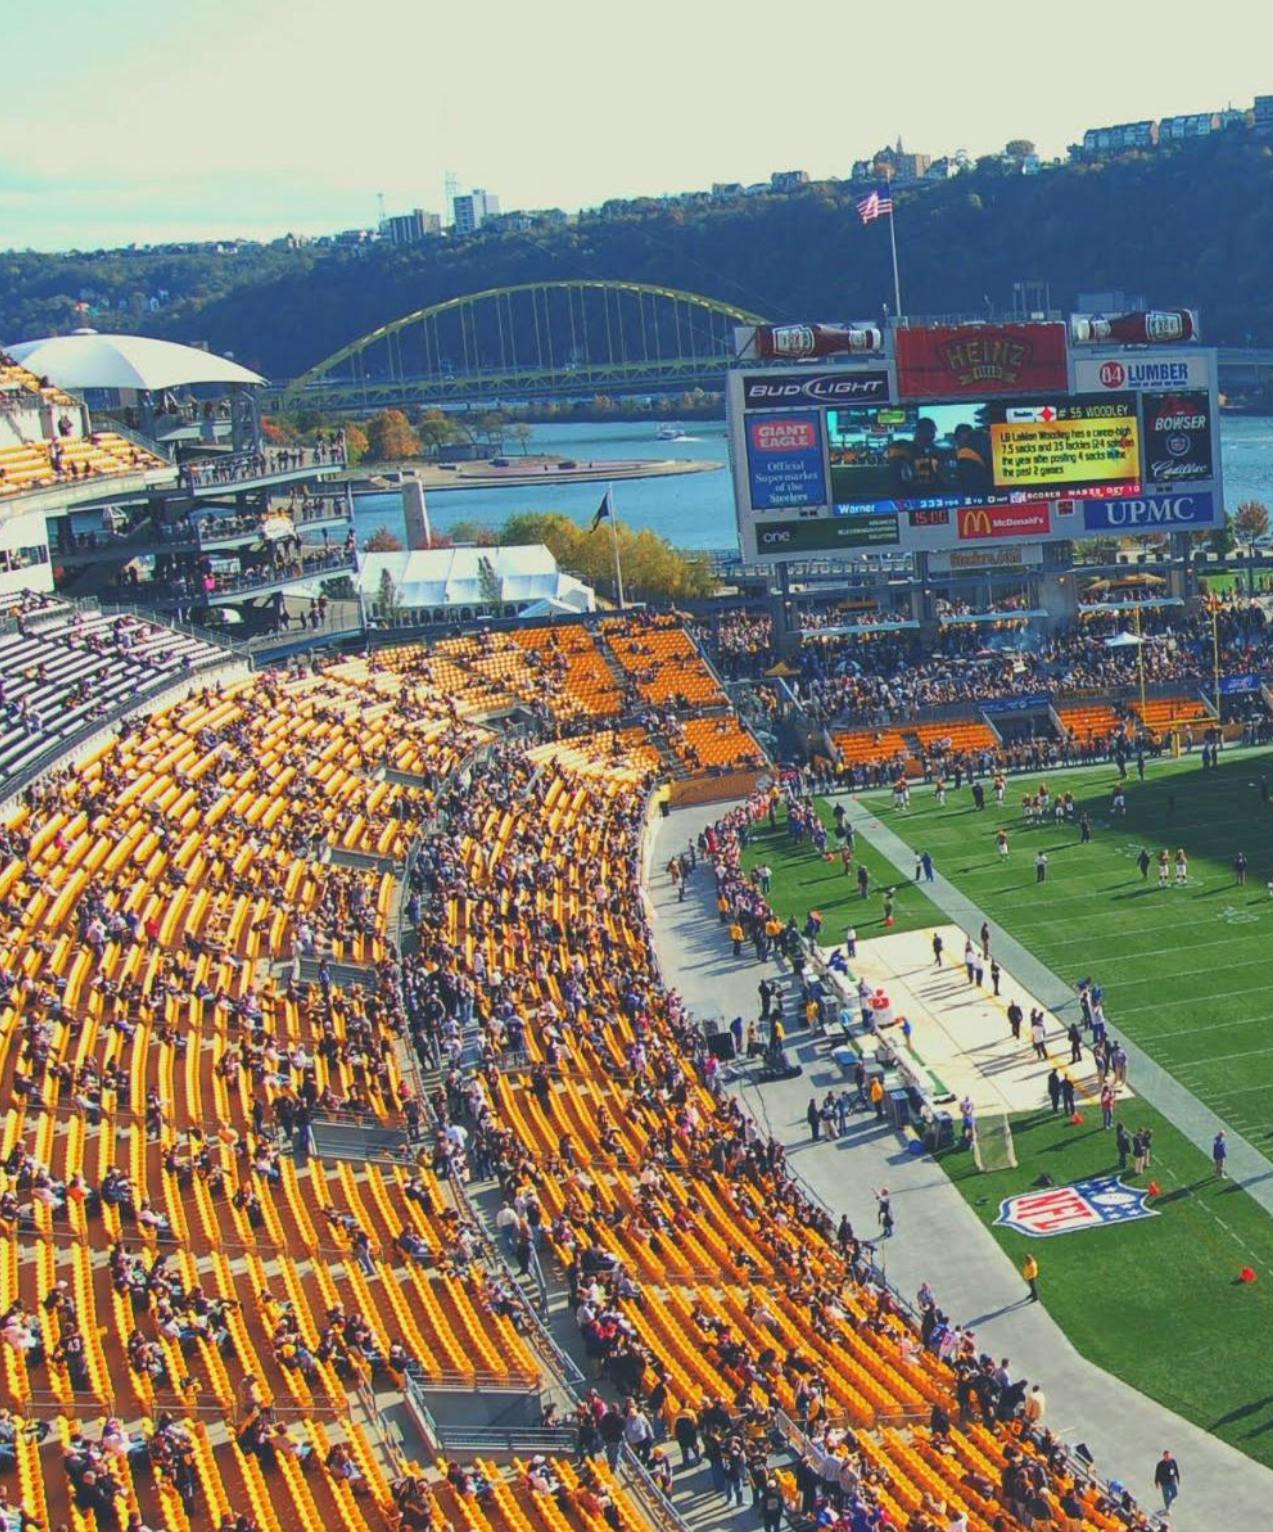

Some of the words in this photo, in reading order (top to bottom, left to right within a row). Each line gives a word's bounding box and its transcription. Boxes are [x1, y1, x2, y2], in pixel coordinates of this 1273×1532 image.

[946, 339, 1025, 370] HEINZ
[1102, 366, 1123, 383] 84
[1128, 363, 1188, 382] LUMBER
[749, 385, 800, 398] BUD
[814, 380, 884, 394] LIGHT
[1086, 405, 1128, 418] WOODLEY
[1155, 415, 1206, 431] BOWSER
[758, 425, 808, 437] GIANT
[759, 436, 808, 448] EAGLE
[767, 461, 805, 472] Official
[775, 481, 786, 492] of
[787, 481, 803, 492] the
[838, 503, 875, 514] Warner
[1105, 497, 1195, 525] UPMC
[992, 516, 1044, 528] McDonald's
[763, 530, 791, 543] one
[1017, 1190, 1093, 1230] NFL
